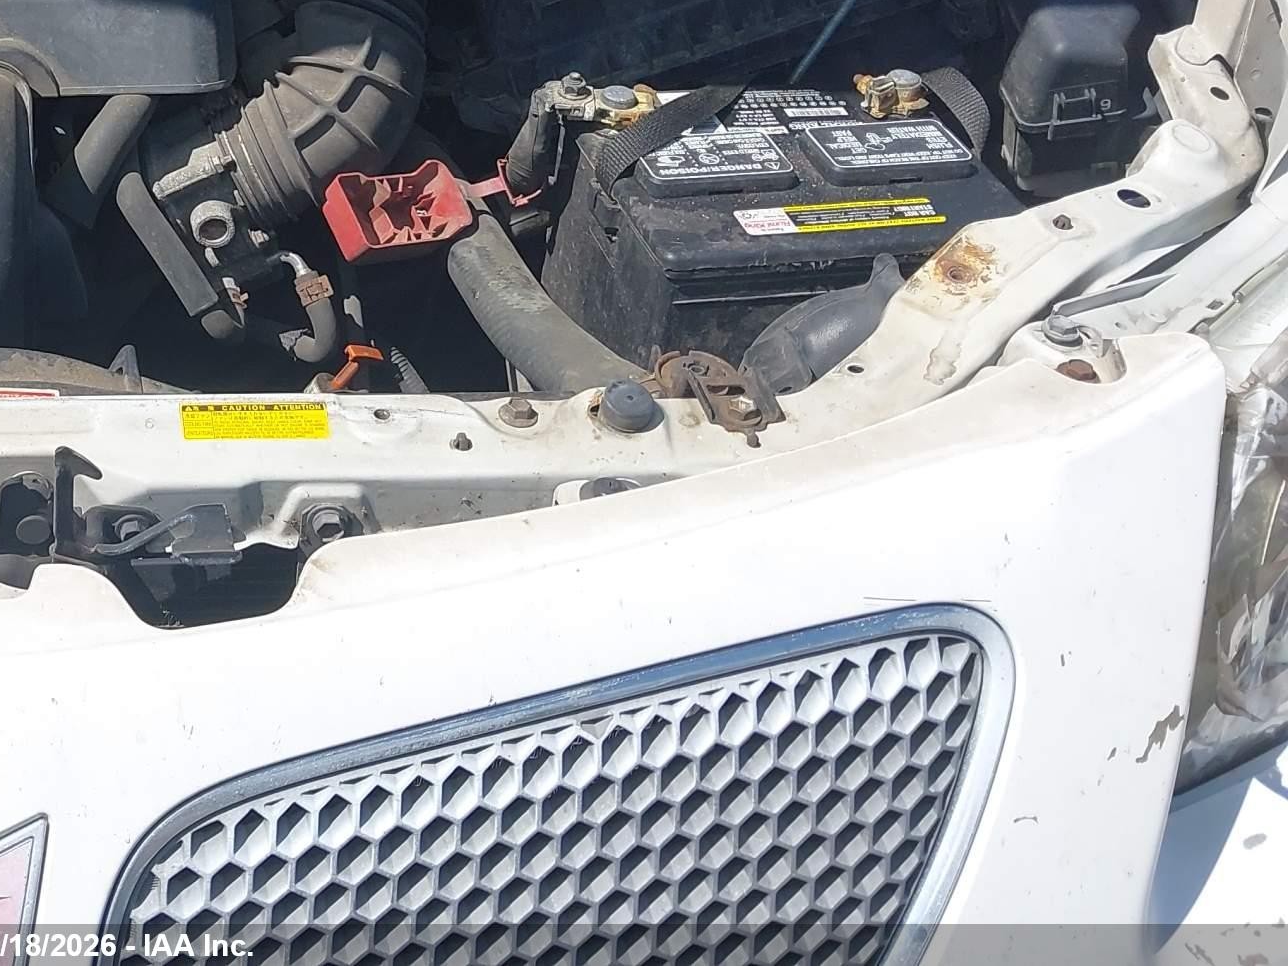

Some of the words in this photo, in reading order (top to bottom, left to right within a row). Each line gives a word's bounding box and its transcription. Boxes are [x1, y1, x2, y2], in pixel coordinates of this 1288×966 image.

[831, 129, 853, 137] FAST
[886, 125, 917, 133] WATER
[825, 141, 862, 150] MEDICAL
[659, 163, 762, 176] DANGER/POISON
